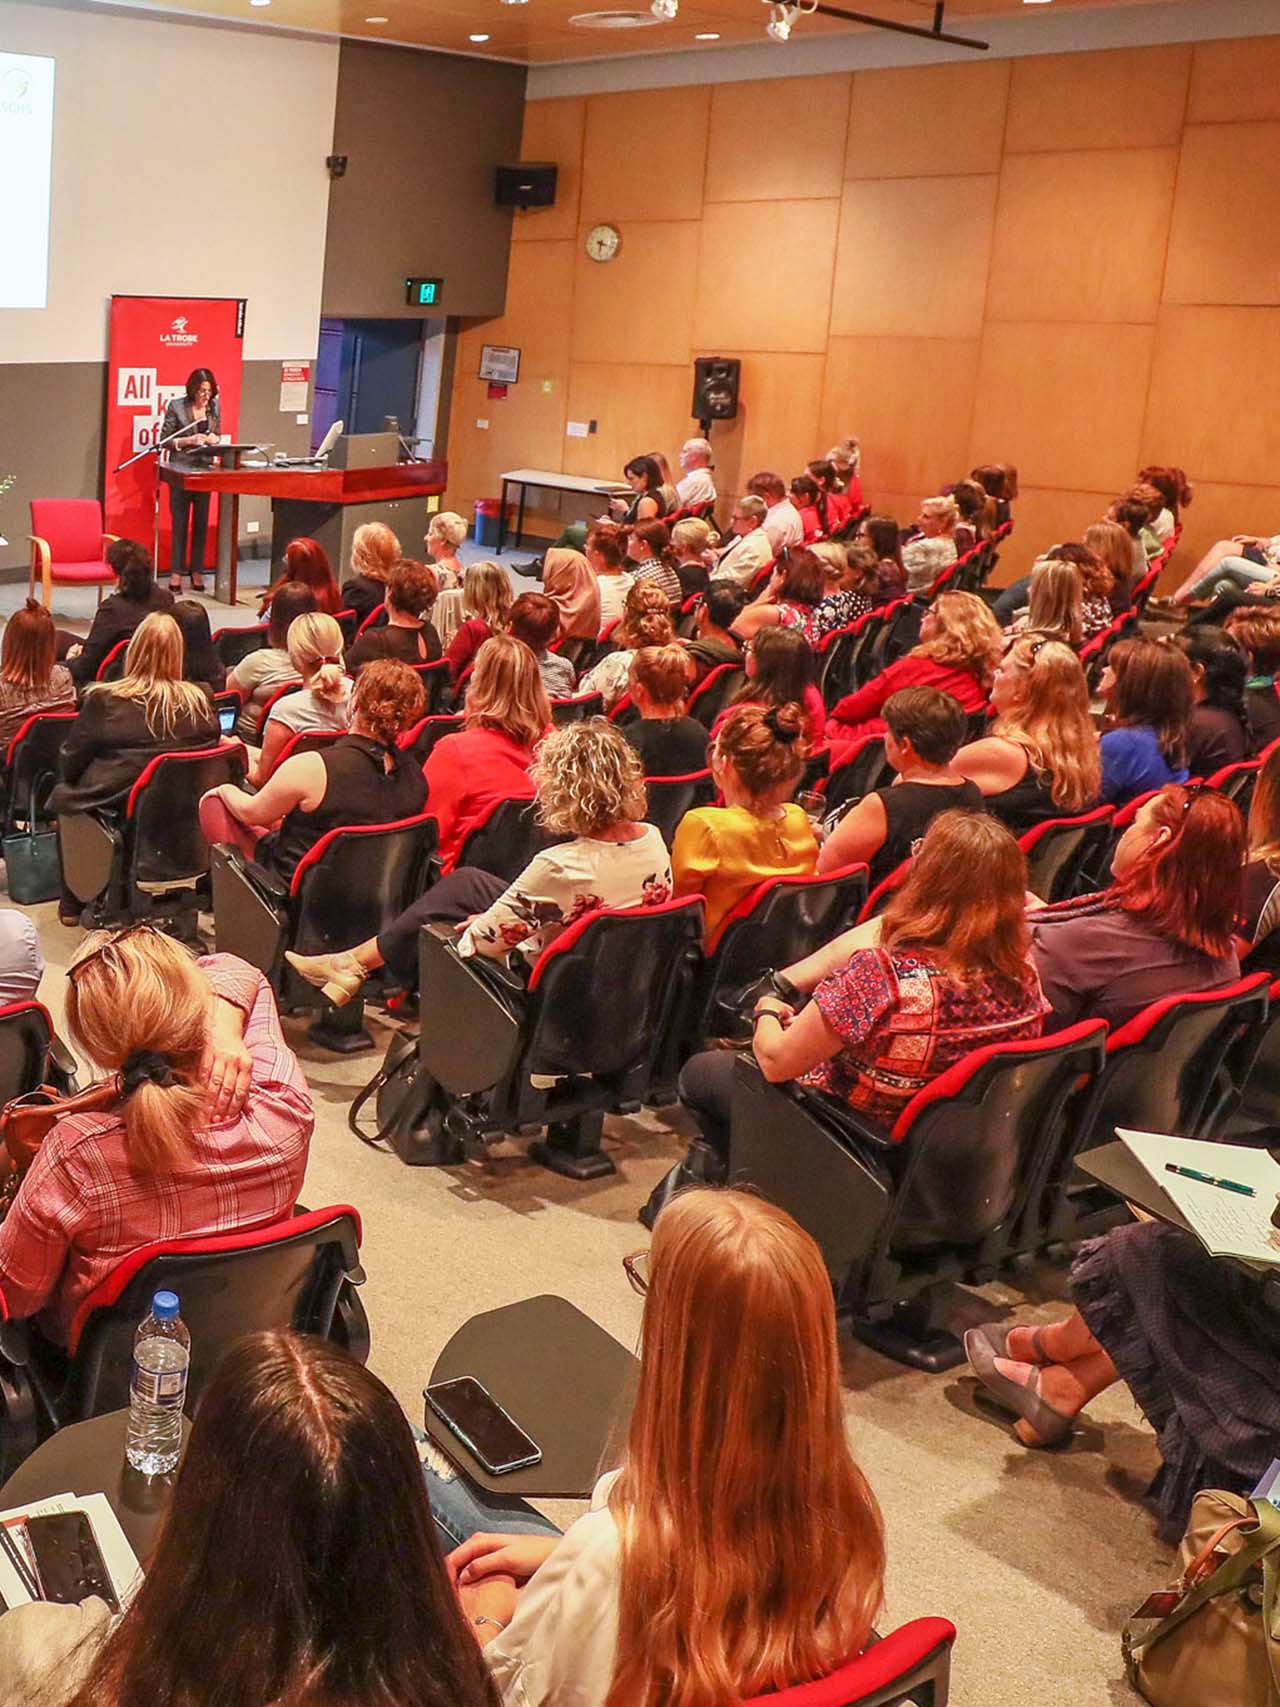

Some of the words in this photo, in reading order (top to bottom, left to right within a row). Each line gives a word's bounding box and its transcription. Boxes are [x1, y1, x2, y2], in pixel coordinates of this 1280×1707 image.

[159, 334, 170, 343] LA
[171, 334, 199, 343] TROBE
[124, 374, 151, 399] All
[138, 421, 161, 447] of
